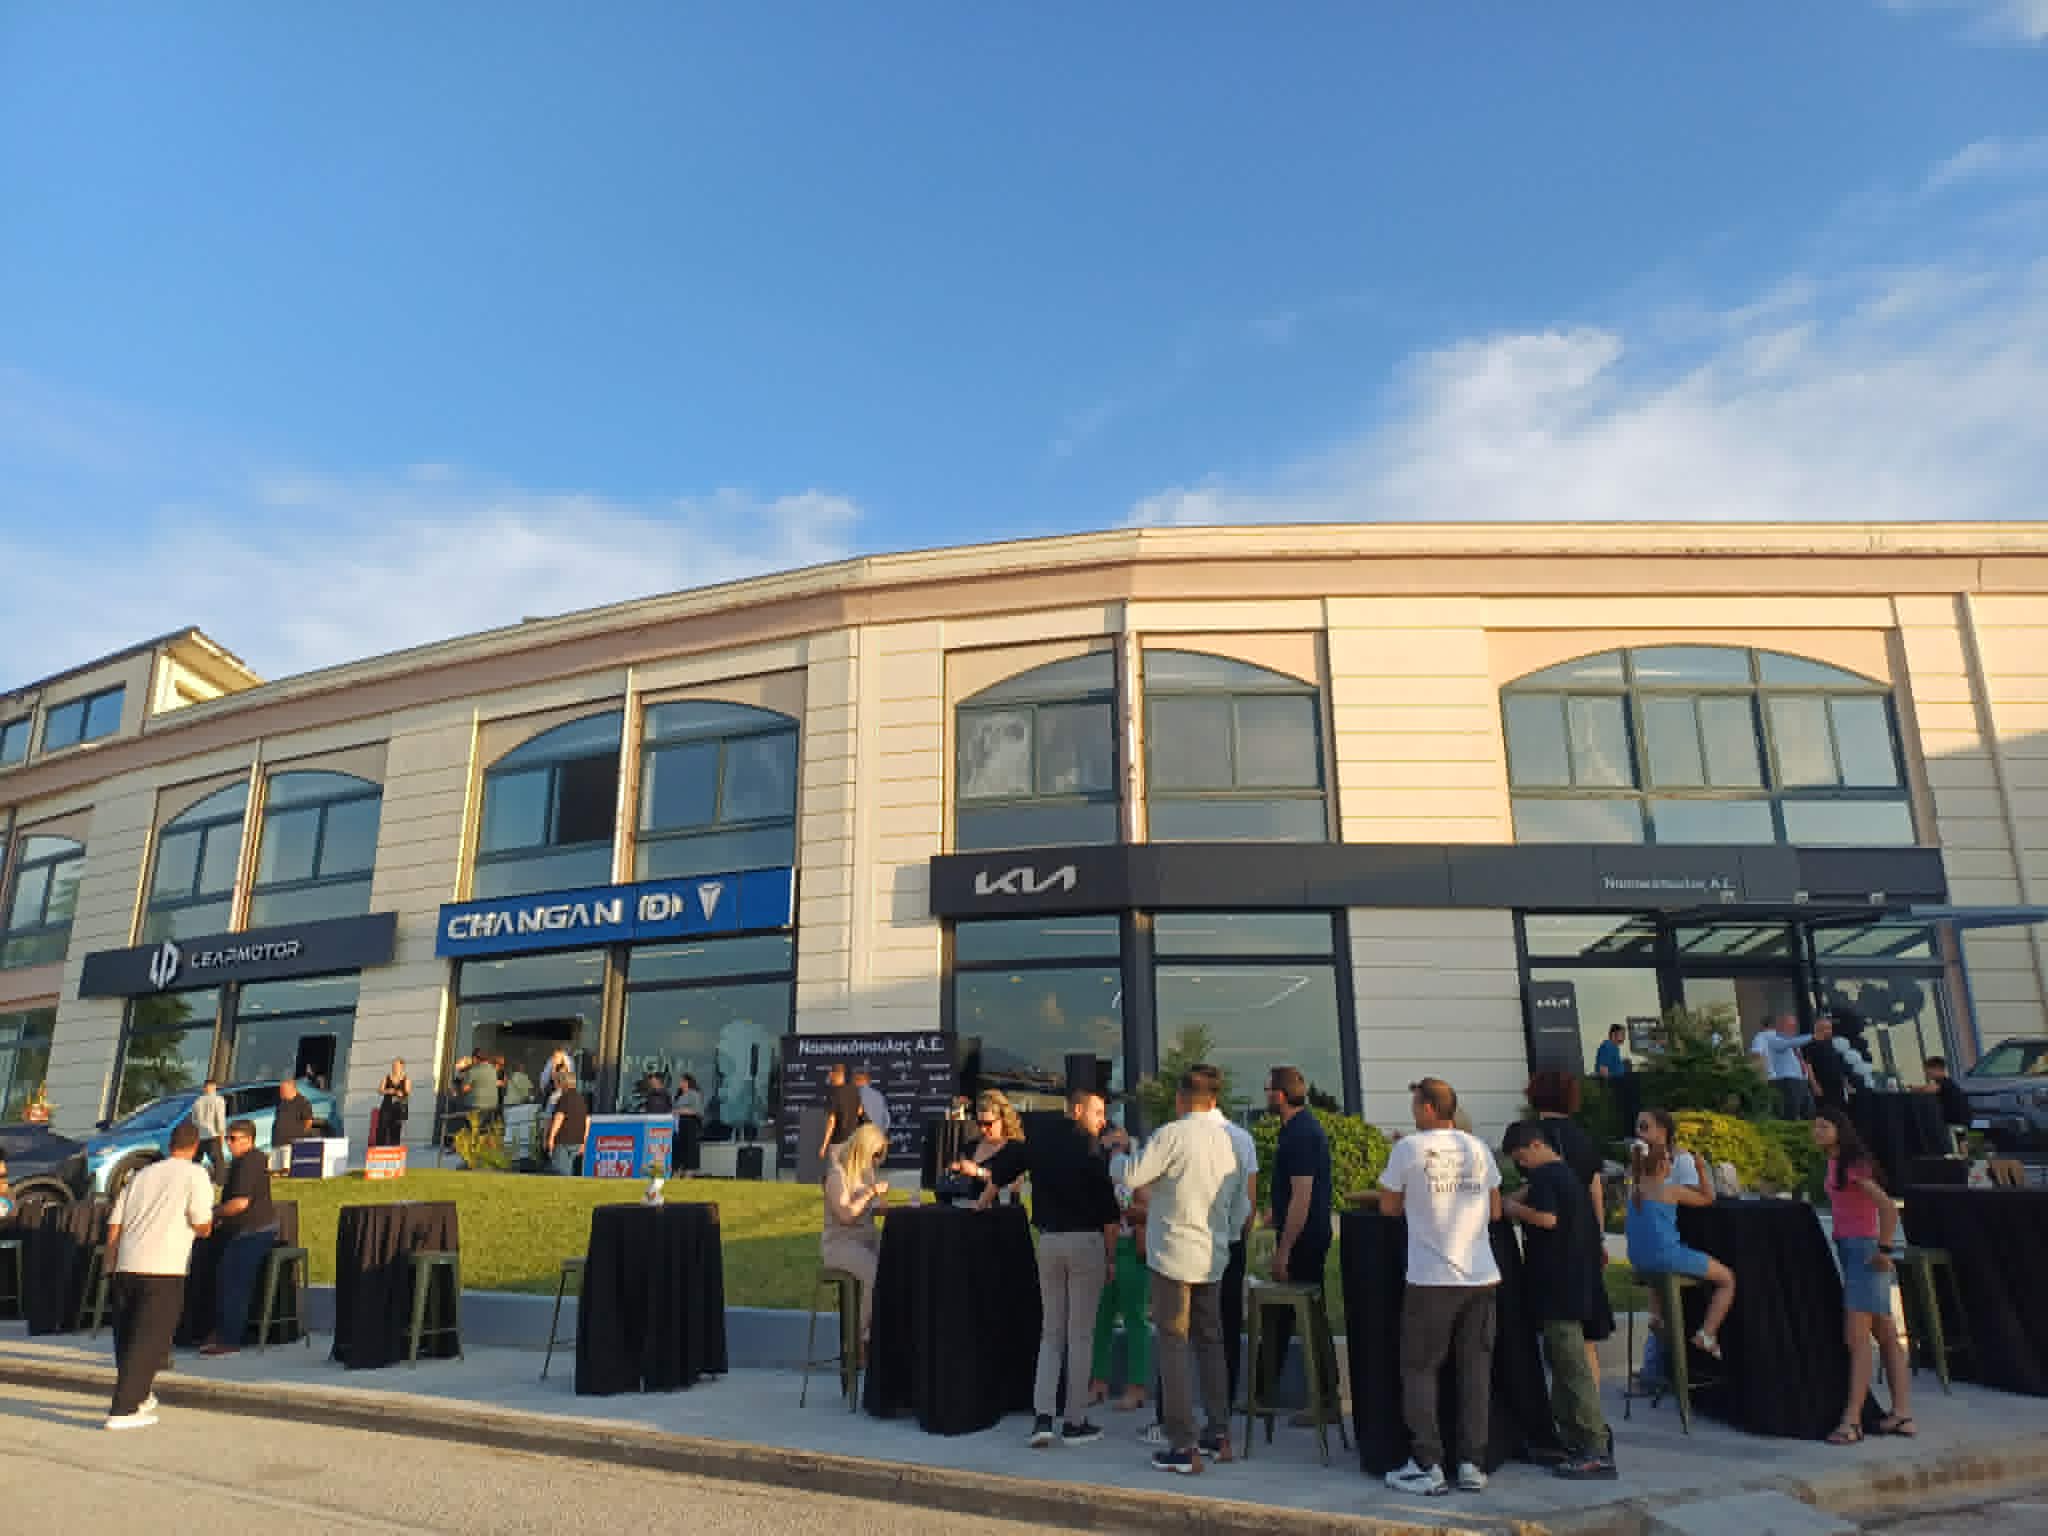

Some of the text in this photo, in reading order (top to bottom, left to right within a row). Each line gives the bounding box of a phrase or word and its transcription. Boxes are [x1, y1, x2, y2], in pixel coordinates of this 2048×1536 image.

[975, 865, 1077, 896] KIA
[447, 899, 623, 940] CHANGAN
[191, 940, 300, 968] LEAPMOTOR
